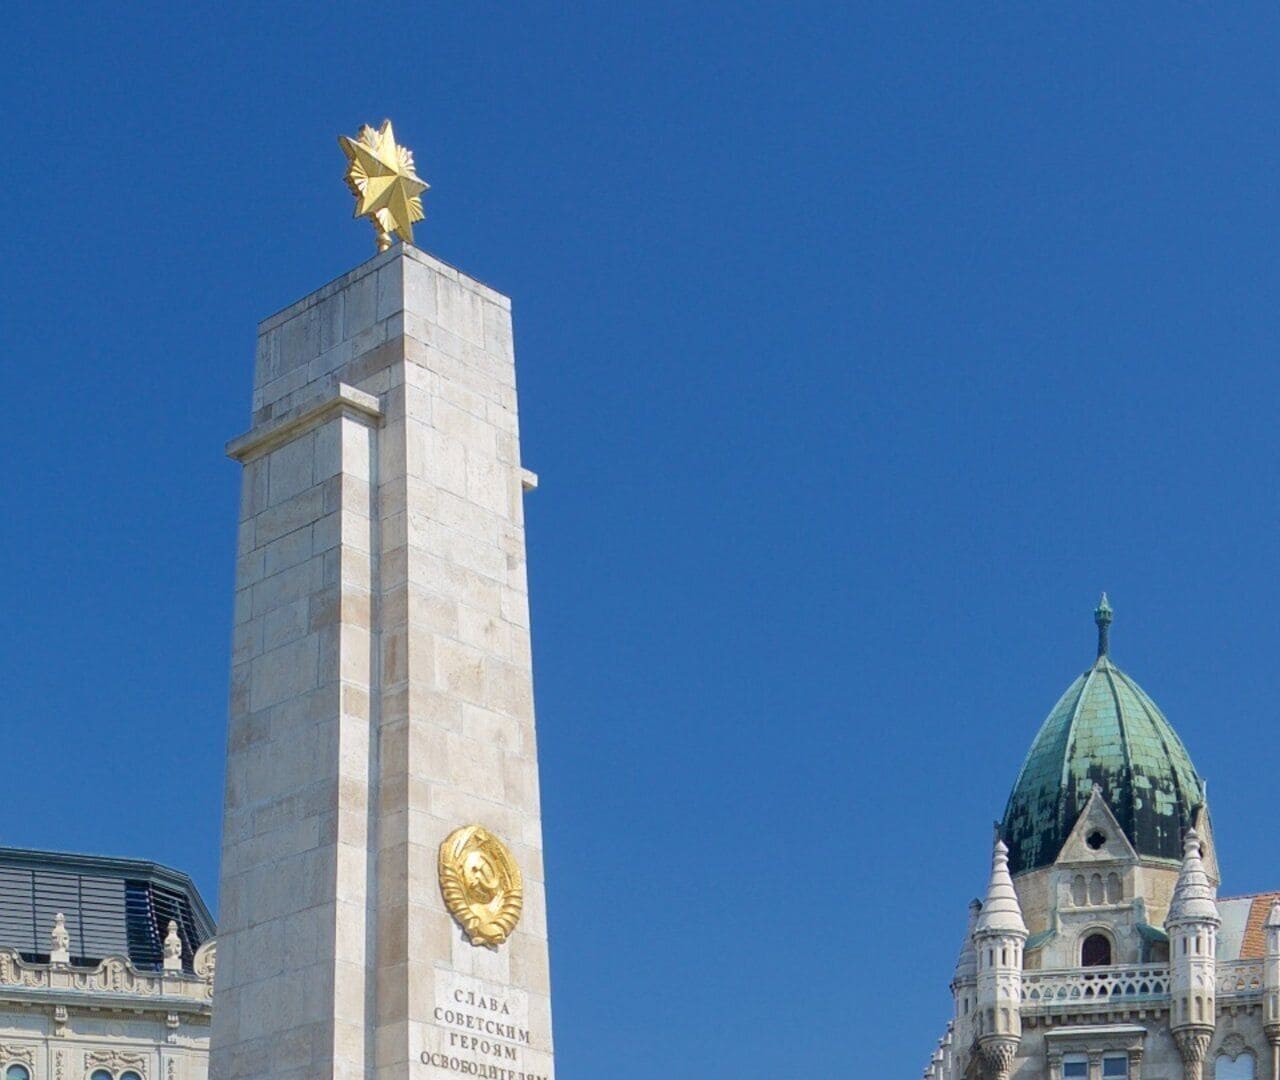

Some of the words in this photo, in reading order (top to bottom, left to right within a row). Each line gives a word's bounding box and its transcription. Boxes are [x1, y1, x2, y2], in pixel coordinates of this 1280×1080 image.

[454, 989, 510, 1015] СЛАВА
[433, 1007, 530, 1044] СОВЕТСКИМ
[449, 1032, 517, 1061] ГЕРОЯМ
